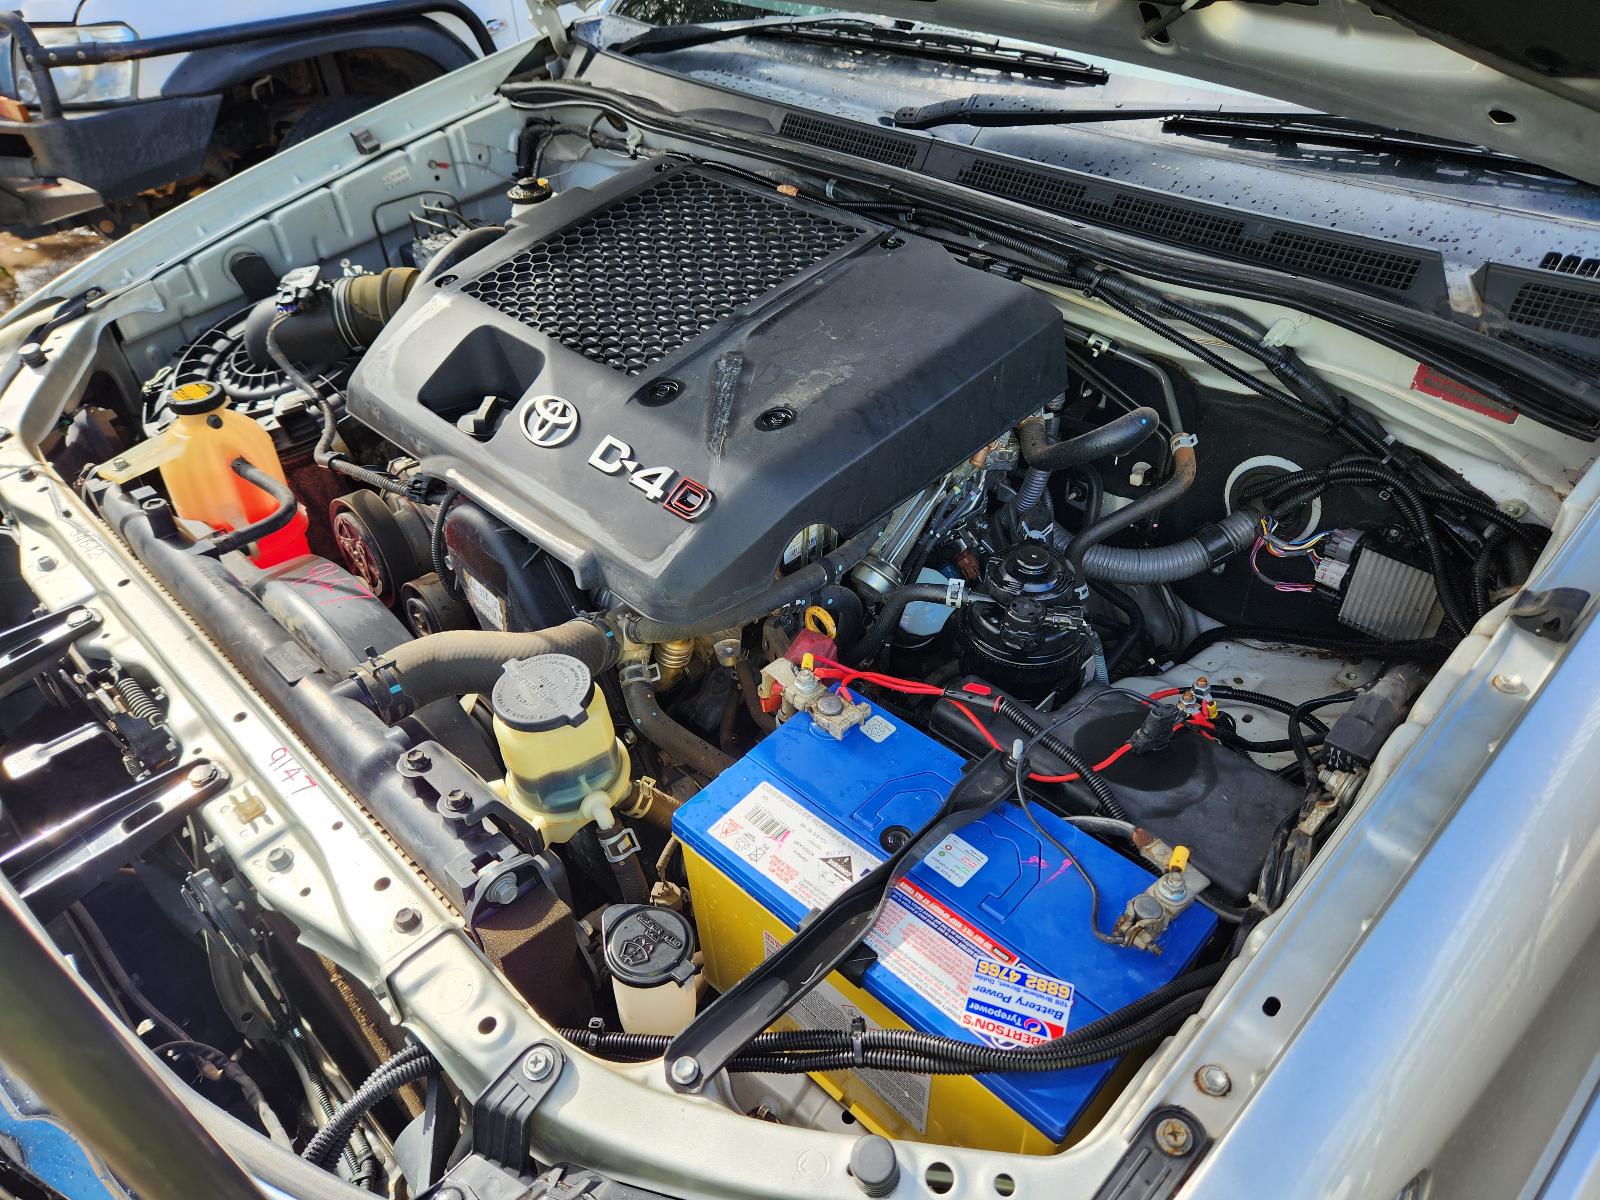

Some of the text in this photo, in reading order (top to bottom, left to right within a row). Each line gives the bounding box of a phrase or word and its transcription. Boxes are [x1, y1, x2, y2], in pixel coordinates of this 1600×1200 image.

[587, 433, 717, 522] D-4D
[269, 746, 316, 794] 9147
[973, 933, 985, 944] NOT
[983, 940, 992, 950] DO
[977, 960, 1070, 999] 6882 4766
[968, 1001, 1022, 1026] Tyrepower
[972, 984, 1063, 1020] Battery Power
[962, 1013, 1046, 1046] BERTSON'S
